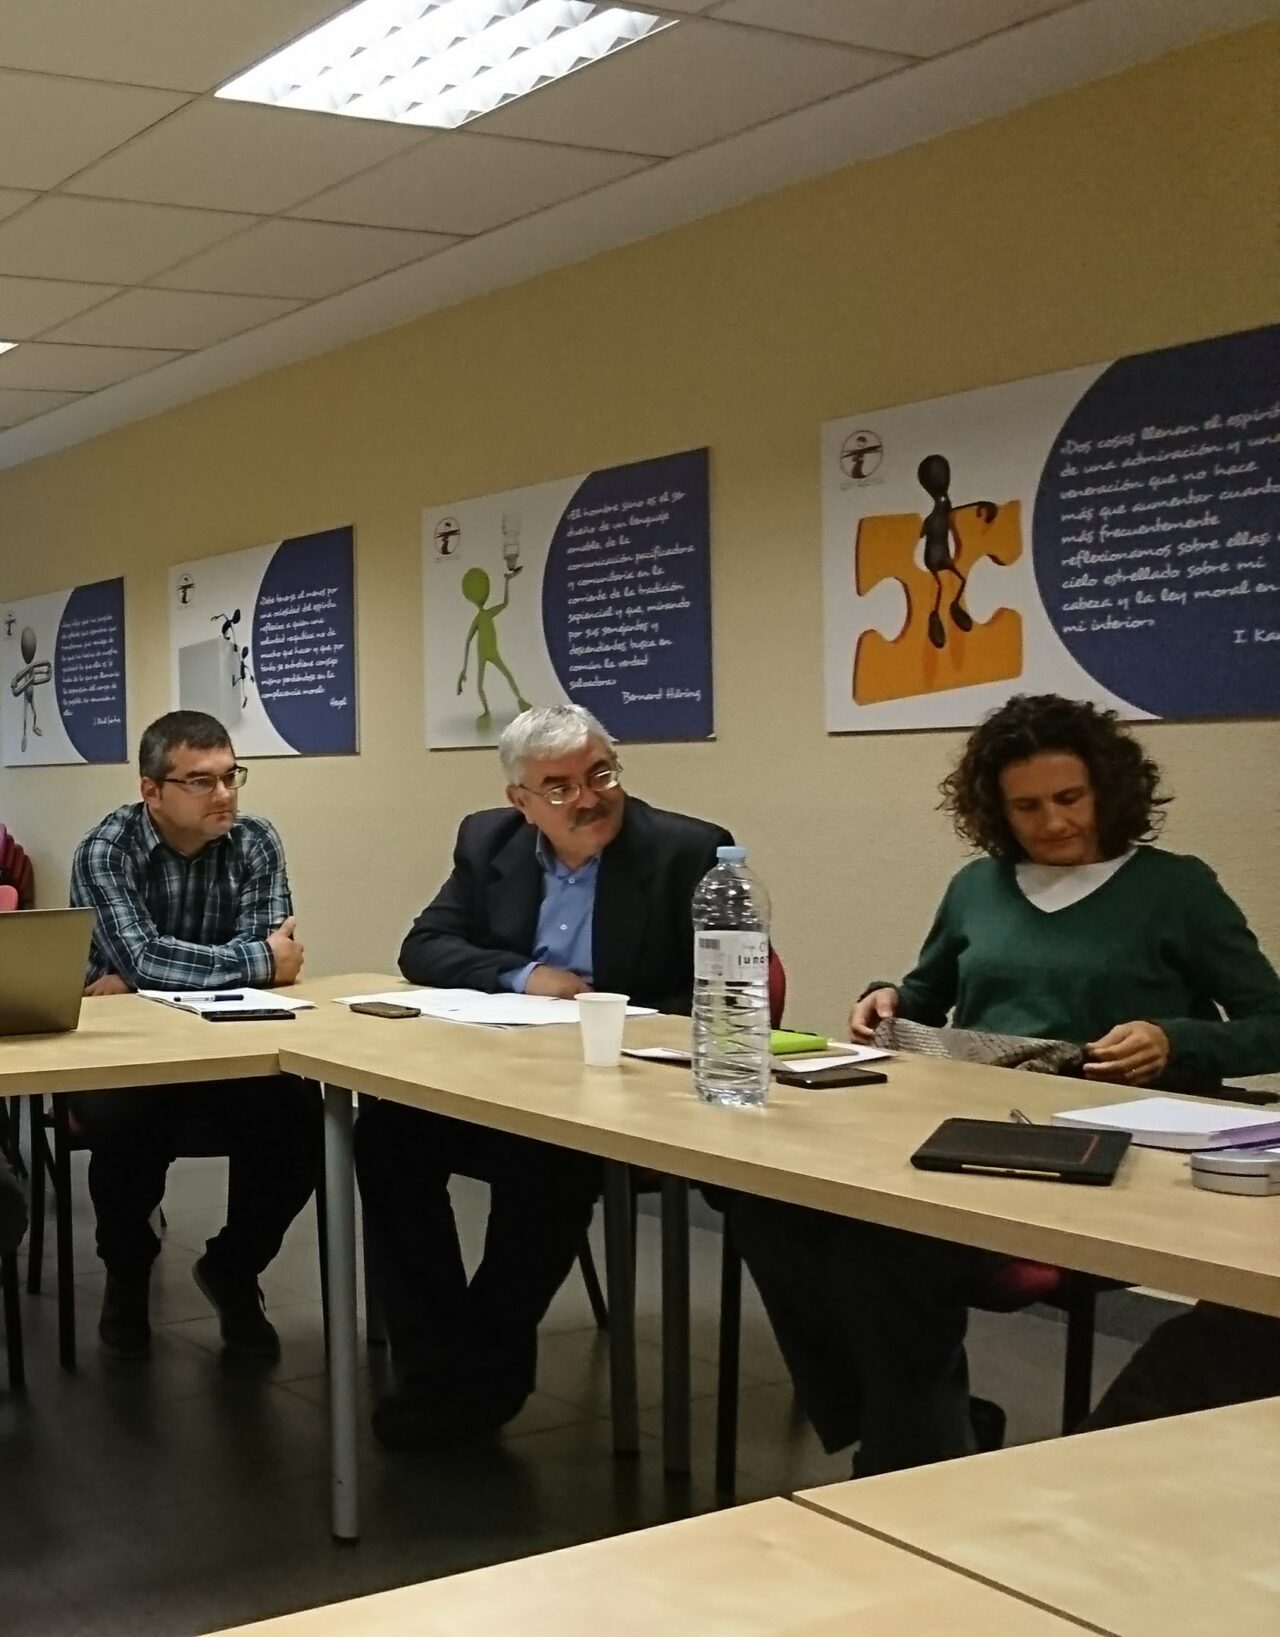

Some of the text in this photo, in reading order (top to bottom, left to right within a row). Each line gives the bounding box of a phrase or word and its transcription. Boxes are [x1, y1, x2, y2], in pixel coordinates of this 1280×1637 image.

[1097, 433, 1135, 449] cosas
[1141, 426, 1200, 441] llenan
[1204, 415, 1223, 430] el
[1227, 405, 1280, 429] espírit
[1060, 434, 1280, 477] de una admiración y una
[1060, 461, 1260, 500] veneración que no hace
[1061, 477, 1280, 522] más que aumentar cuanto
[599, 520, 611, 532] de
[1061, 509, 1221, 545] más frecuentemente
[605, 536, 616, 548] de
[619, 534, 631, 545] la
[1061, 544, 1173, 568] reflexionamos
[1177, 537, 1221, 557] sobre
[567, 542, 696, 571] comunicación pacificadora
[567, 564, 665, 591] y comunitaria en la
[1062, 556, 1266, 589] cielo estrellado sobre mi
[568, 581, 686, 605] corriente de la tradición
[1062, 579, 1280, 611] cabeza y la ley moral en
[568, 606, 614, 624] sapiencial
[615, 609, 623, 619] y
[647, 596, 691, 612] mirando
[568, 619, 659, 642] por sus semejantes y
[1063, 621, 1087, 633] mi
[630, 638, 657, 650] busca
[658, 638, 673, 646] en
[569, 653, 649, 672] común la verdad
[622, 688, 663, 704] Bernard
